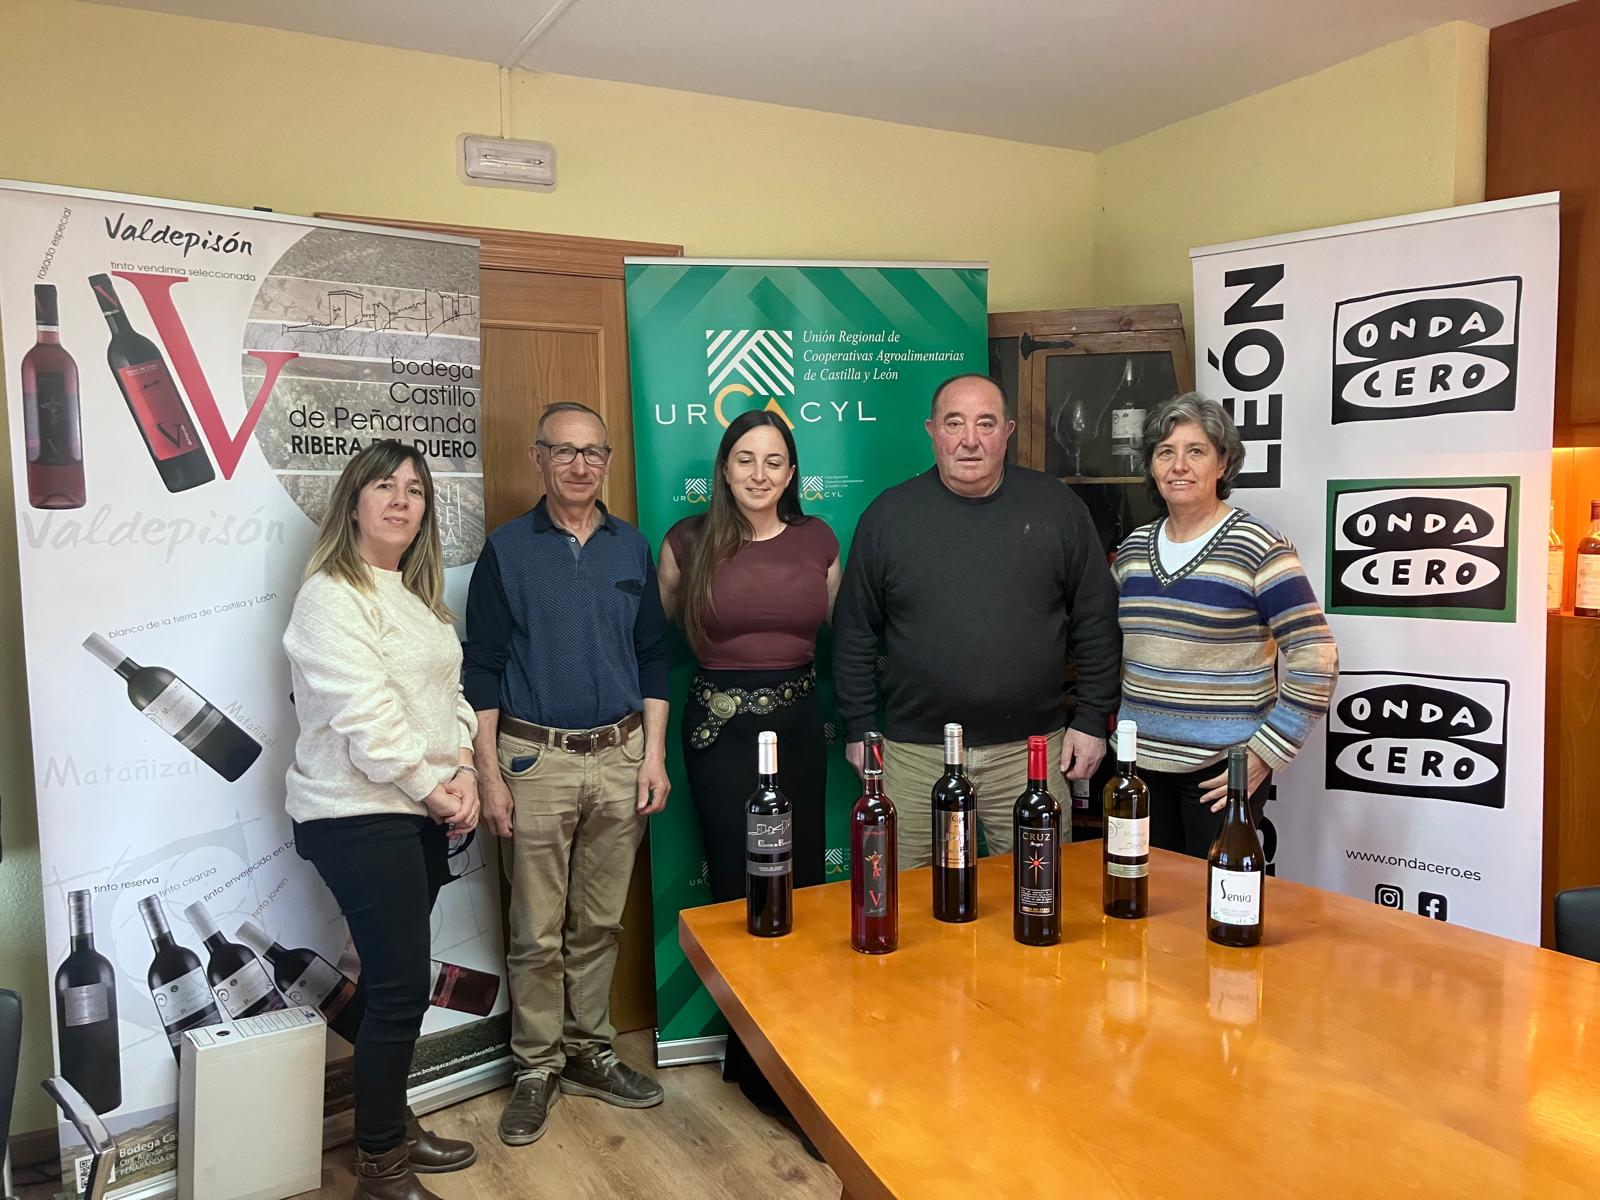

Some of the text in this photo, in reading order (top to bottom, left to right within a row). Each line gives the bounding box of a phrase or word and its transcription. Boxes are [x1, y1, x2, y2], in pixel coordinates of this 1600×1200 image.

[37, 207, 72, 280] rosado especial
[104, 213, 253, 257] Valdepisón
[110, 261, 256, 282] tinto vendimia seleccionada
[802, 329, 901, 345] Unión Regional de
[1357, 311, 1487, 348] ONDA
[391, 356, 474, 382] bodega
[802, 349, 965, 365] Cooperativas Agroalimentarias
[803, 367, 900, 383] de Castilla y León
[1207, 264, 1285, 488] LEÓN
[1363, 363, 1486, 398] CERO
[389, 381, 476, 408] Castillo
[289, 404, 477, 434] de Peñaranda
[290, 434, 362, 456] RIBERA
[414, 440, 477, 459] DUERO
[21, 504, 285, 564] Valdepisón
[1356, 512, 1479, 537] ONDA
[1362, 558, 1478, 586] CERO
[108, 624, 144, 640] blanco
[147, 620, 160, 630] de
[161, 617, 172, 626] la
[173, 611, 198, 624] tierra
[200, 608, 212, 617] de
[214, 598, 247, 614] Castilla
[255, 591, 277, 604] León
[225, 700, 276, 748] Matañizal
[1350, 697, 1476, 729] ONDA
[43, 754, 200, 790] Matañizal
[1356, 744, 1477, 781] CERO
[1022, 832, 1051, 841] CRUZ
[203, 885, 224, 903] tinto
[225, 854, 272, 888] envejecido
[273, 844, 286, 857] en
[1345, 849, 1482, 882] www.ondacero.es
[94, 876, 159, 894] tinto reserva
[159, 866, 217, 899] tinto crianza
[251, 876, 289, 918] tinto joven
[1220, 879, 1252, 903] Sensia
[119, 1139, 160, 1158] Bodega
